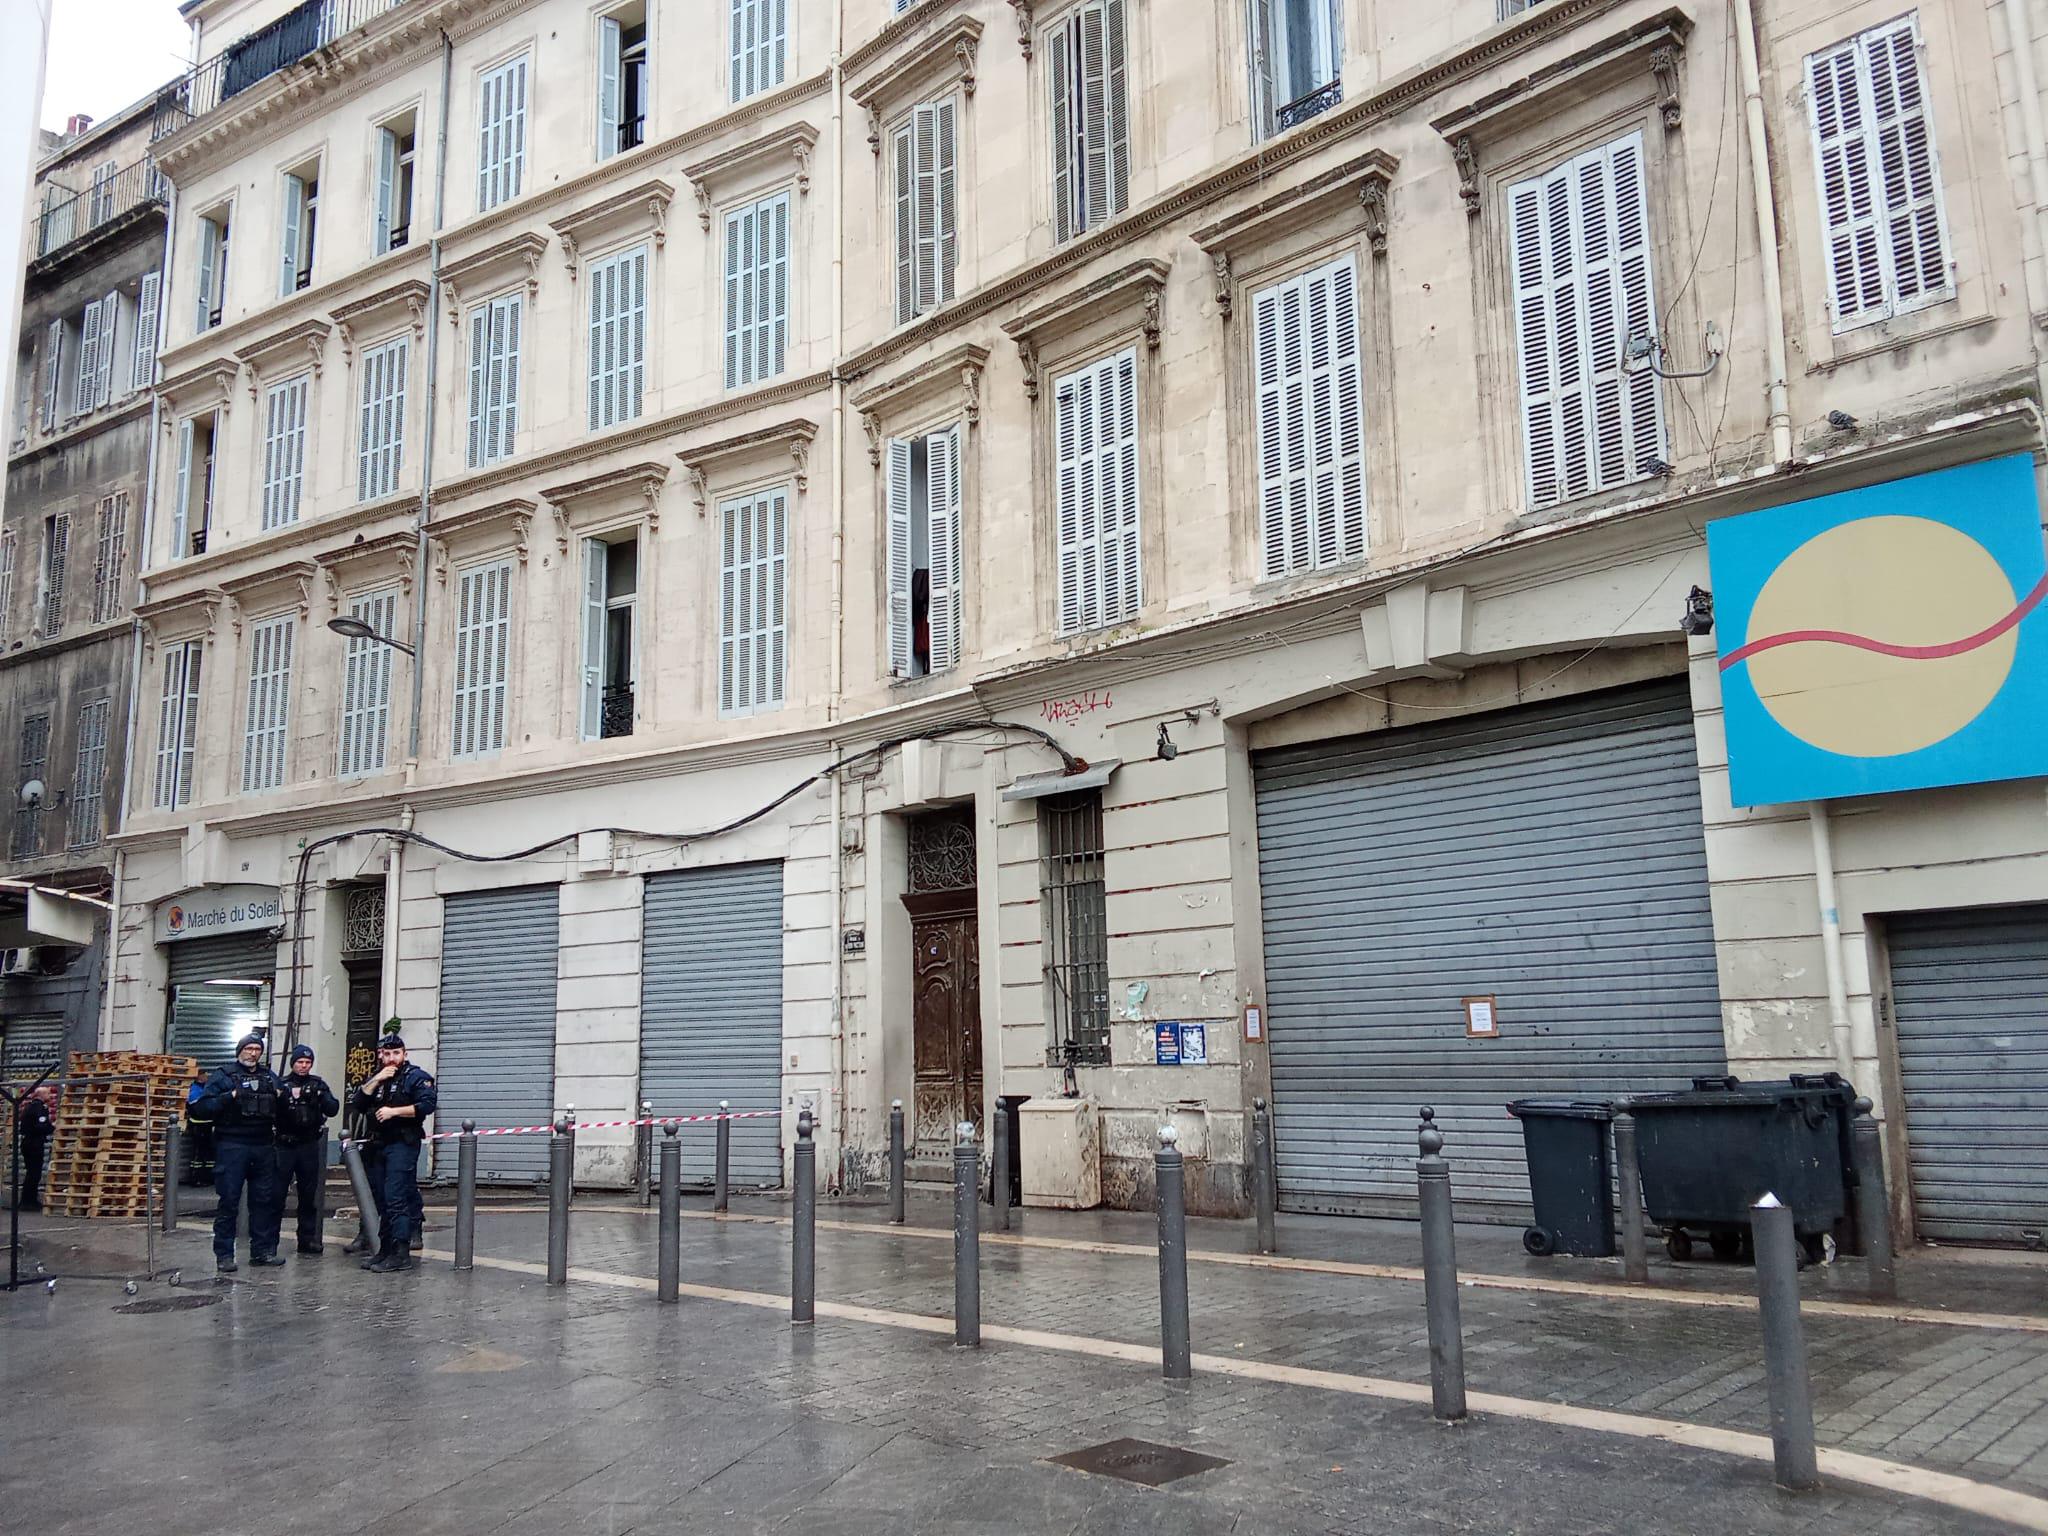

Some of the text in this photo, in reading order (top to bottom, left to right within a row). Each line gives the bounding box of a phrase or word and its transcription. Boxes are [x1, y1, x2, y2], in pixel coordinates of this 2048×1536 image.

[187, 900, 280, 928] Marché du Soleil
